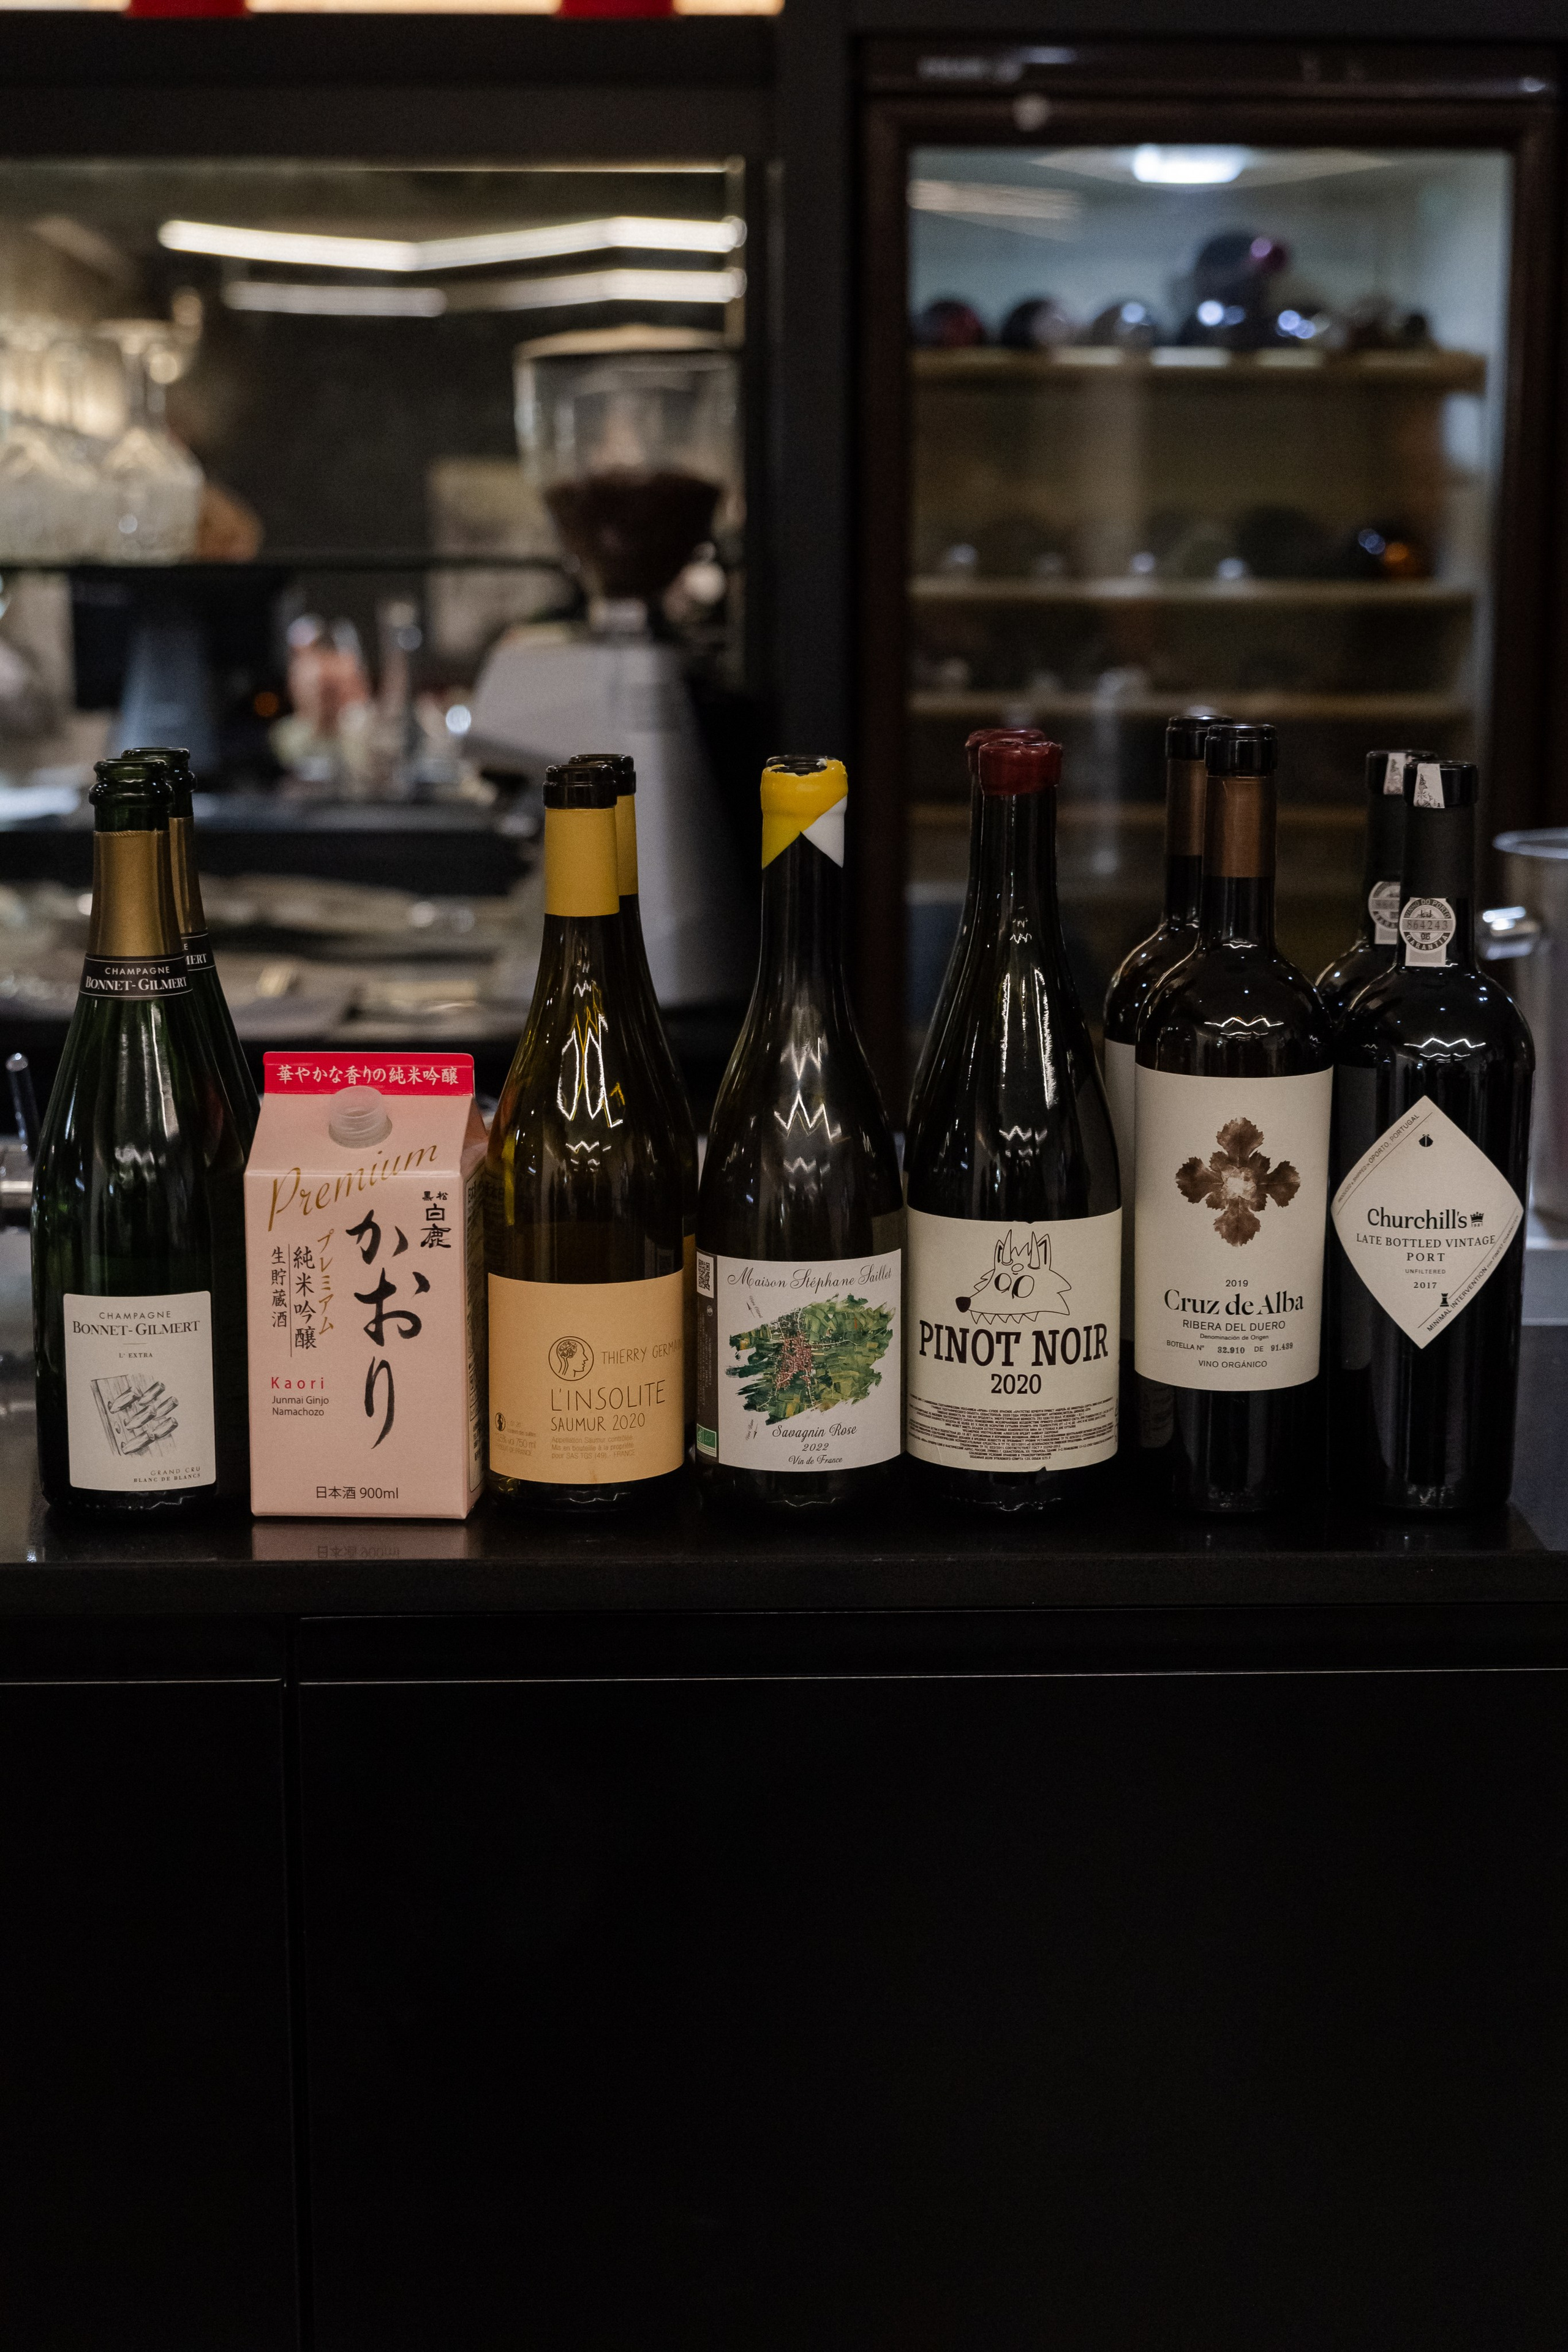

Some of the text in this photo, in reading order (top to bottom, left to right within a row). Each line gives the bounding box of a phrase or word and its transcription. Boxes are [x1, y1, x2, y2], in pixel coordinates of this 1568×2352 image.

[1432, 900, 1450, 918] PORTO
[1406, 935, 1448, 950] GARANTIA
[105, 966, 170, 975] CHAMPAGNE
[86, 976, 187, 991] BONNET-GILMERT
[277, 1064, 459, 1085] 華やかな香りの純米吟醸
[1389, 1115, 1420, 1142] PORTUGAL
[268, 1145, 437, 1231] Premium
[422, 1191, 448, 1201] 黒松
[420, 1203, 452, 1248] 白鹿
[1367, 1207, 1468, 1229] Churchill's
[1356, 1234, 1496, 1248] LATE BOTTLED VINTAGE
[1406, 1253, 1445, 1262] PORT
[271, 1246, 287, 1328] 生貯蔵酒
[317, 1228, 334, 1335] プレミアム
[727, 1267, 788, 1289] Maison
[790, 1268, 856, 1294] Stéphane
[293, 1246, 317, 1350] 純米吟醸
[1164, 1289, 1303, 1316] Cruz de Alba
[1427, 1308, 1452, 1332] MINIMAL
[1450, 1267, 1487, 1309] INTERVENTION
[99, 1311, 171, 1319] CHAMPAGNE
[72, 1321, 200, 1335] BONNET-GILMERT
[345, 1209, 431, 1449] かおり
[1183, 1319, 1286, 1332] RIBERA DEL DUERO
[919, 1320, 1109, 1367] PINOT NOIR
[1166, 1340, 1194, 1350] BOTELLA
[601, 1346, 647, 1365] THIERRY
[1221, 1360, 1267, 1368] ORGÁNICO
[271, 1377, 325, 1389] Kaori
[990, 1373, 1041, 1395] 2020
[306, 1396, 330, 1406] Ginjo
[551, 1379, 665, 1411] L'INSOLITE
[272, 1408, 325, 1416] Namachozo
[551, 1416, 606, 1432] SAUMUR
[612, 1412, 646, 1431] 2020
[772, 1422, 858, 1442] Savagnin Rose
[802, 1443, 829, 1452] 2022
[788, 1455, 804, 1465] Vin
[816, 1454, 843, 1464] France
[316, 1486, 399, 1499] 日本酒 900ml
